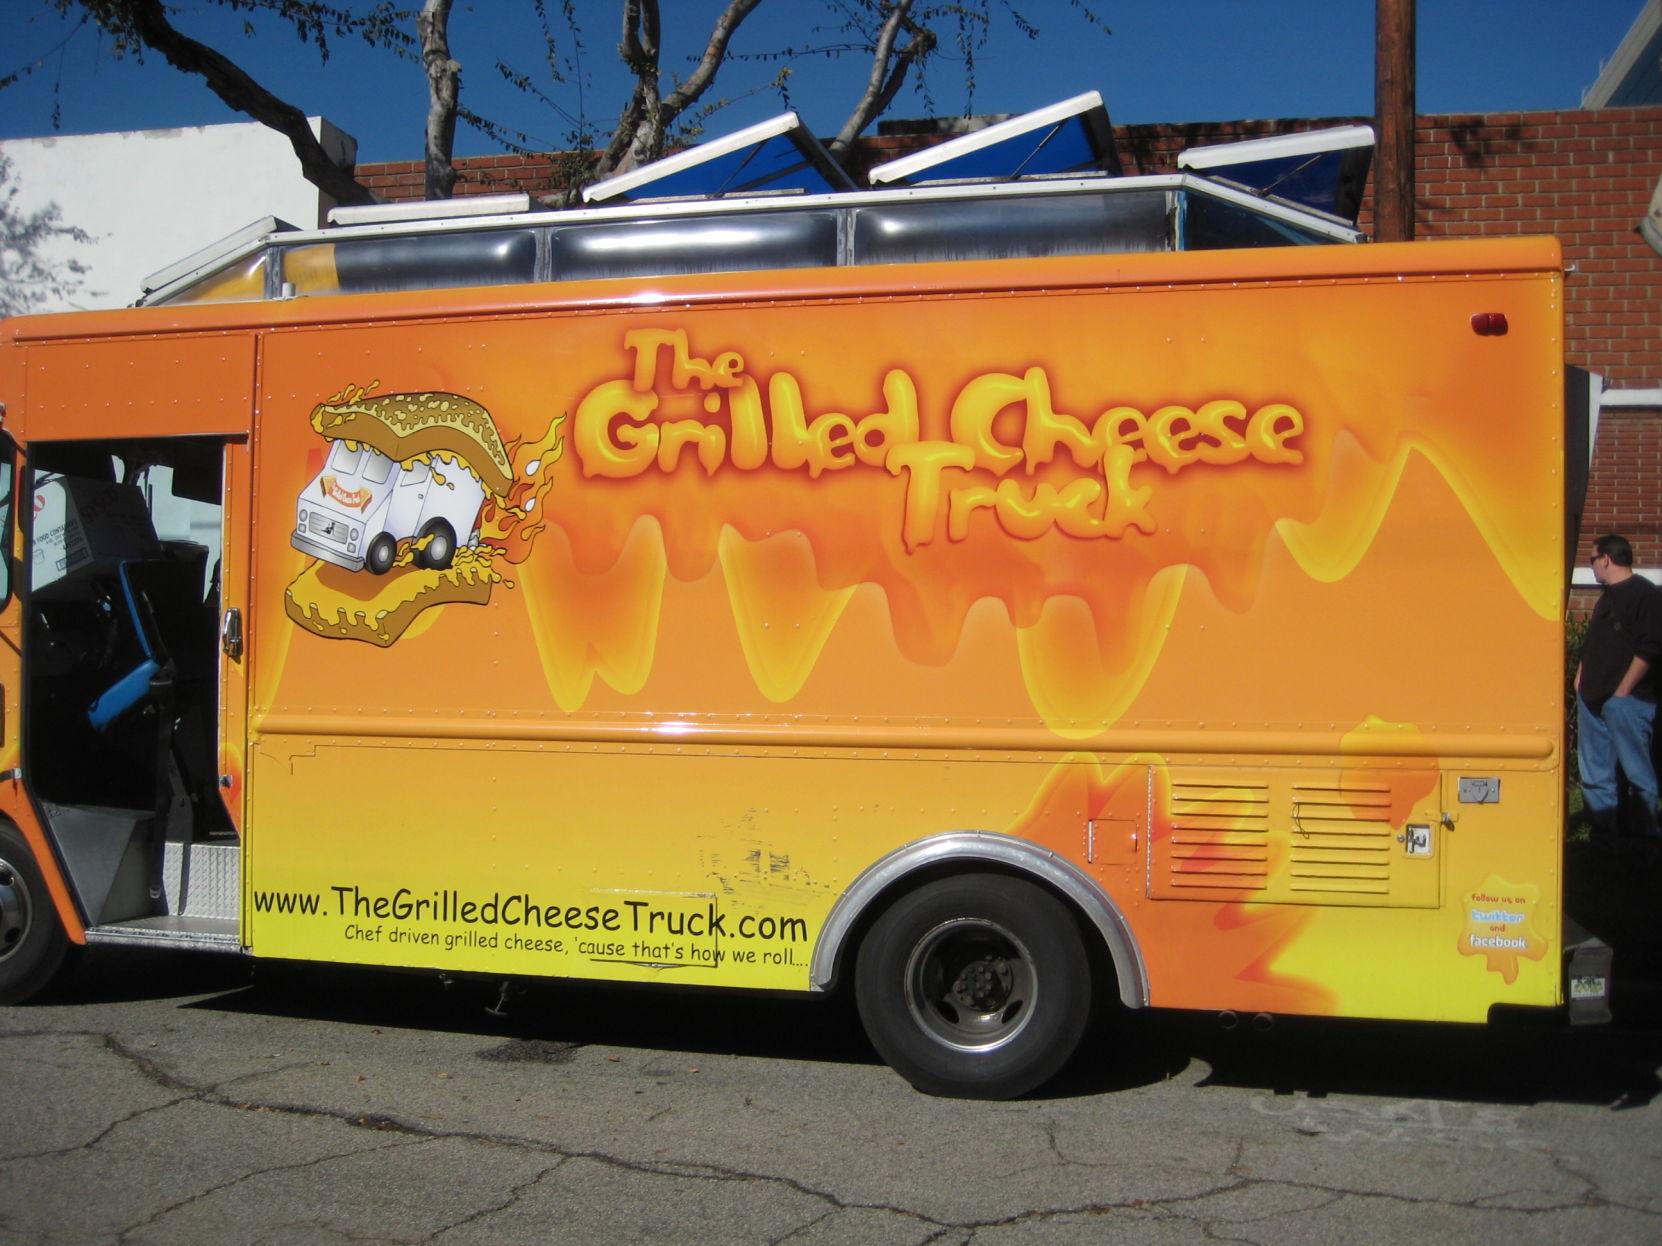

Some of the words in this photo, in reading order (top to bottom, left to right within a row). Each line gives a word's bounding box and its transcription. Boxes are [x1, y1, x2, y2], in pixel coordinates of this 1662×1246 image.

[624, 328, 744, 392] The
[574, 368, 918, 479] Grilled
[950, 366, 1304, 475] Cheese
[886, 441, 1157, 554] Truck
[1471, 893, 1499, 904] follow
[1502, 896, 1512, 904] us
[1471, 909, 1525, 923] twitter
[1489, 924, 1506, 933] and
[344, 924, 383, 943] Chef
[388, 927, 440, 945] driven
[444, 931, 498, 951] grilled
[504, 931, 569, 956] cheese,
[631, 940, 684, 960] that's
[691, 942, 726, 962] how
[732, 949, 757, 964] we
[1470, 935, 1526, 948] facebook
